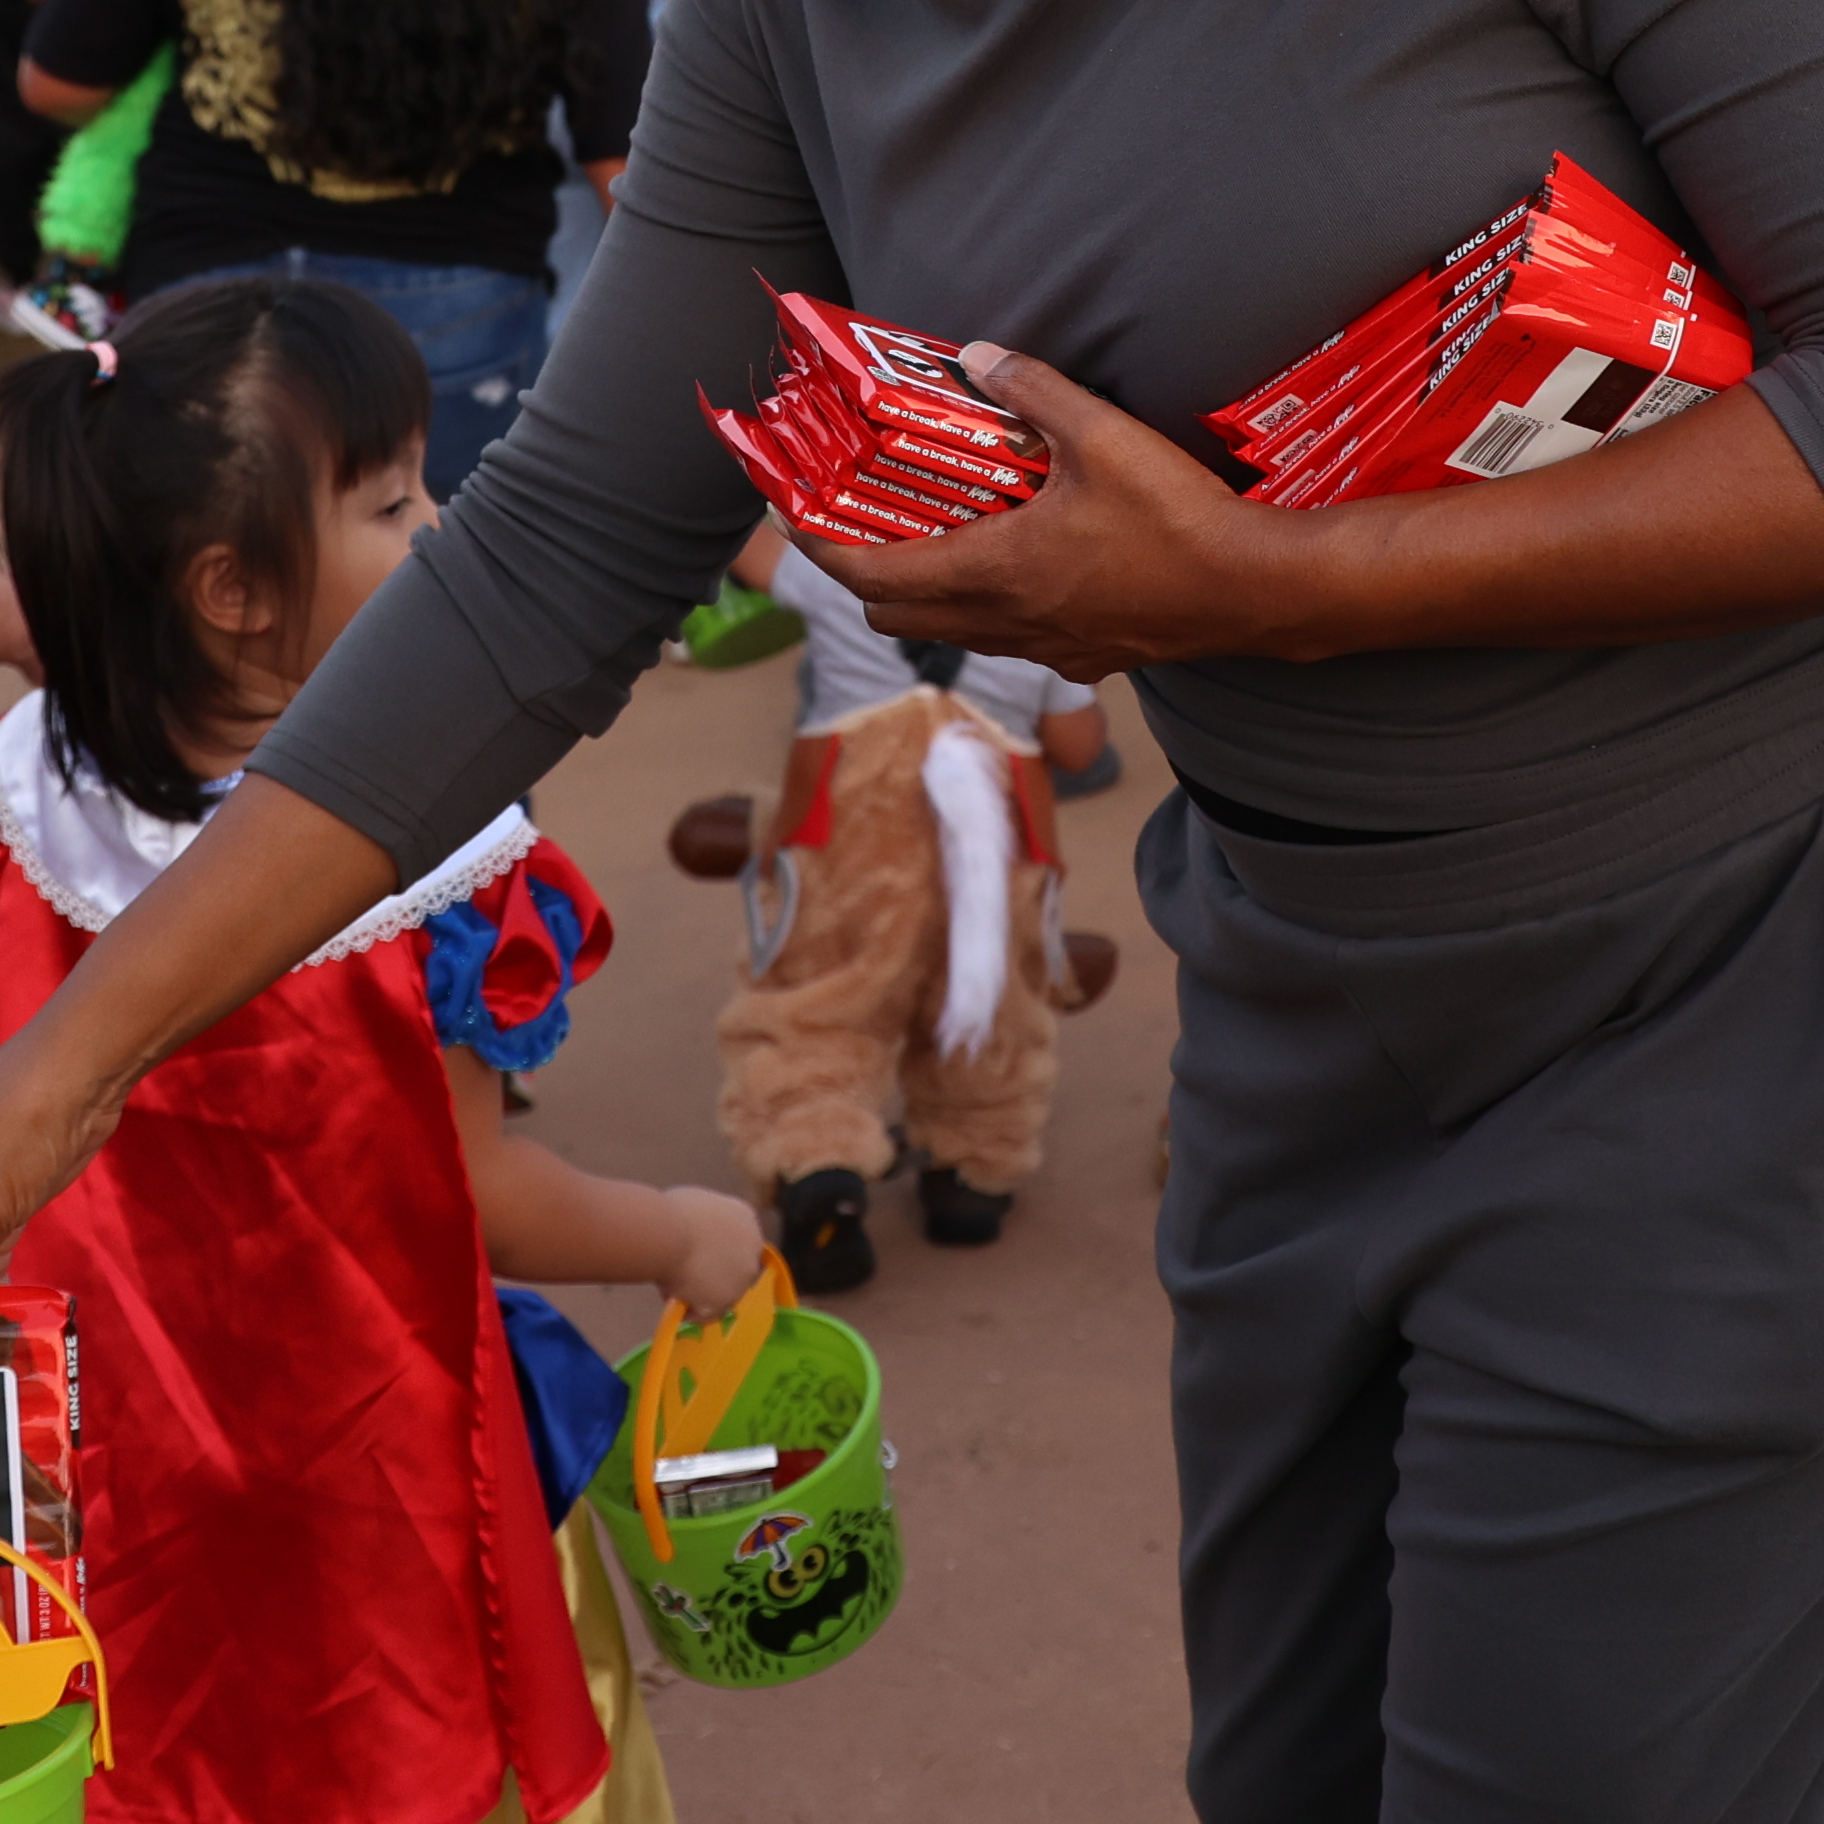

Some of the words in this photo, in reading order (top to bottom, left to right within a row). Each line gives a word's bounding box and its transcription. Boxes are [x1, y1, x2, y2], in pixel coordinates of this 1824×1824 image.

[1445, 230, 1487, 266] KING
[1453, 258, 1492, 296] KING
[1496, 232, 1526, 262] SIZ
[1441, 294, 1478, 333] KING
[1481, 267, 1510, 297] SIZ
[1429, 352, 1460, 392] KING
[1463, 315, 1492, 351] SIZE
[1647, 401, 1661, 415] size
[1658, 379, 1681, 403] Serving
[878, 399, 900, 416] have
[901, 409, 908, 419] a
[909, 410, 938, 429] break,
[939, 419, 962, 437] have
[963, 429, 970, 439] a
[970, 428, 999, 447] KitKat
[874, 452, 897, 469] have
[898, 462, 905, 472] a
[906, 463, 936, 484] break,
[937, 474, 960, 492] have
[960, 483, 968, 493] a
[967, 484, 997, 503] KitKat
[898, 438, 921, 455] have
[922, 447, 929, 457] a
[929, 448, 959, 469] break,
[960, 458, 983, 476] have
[983, 467, 991, 477] a
[990, 467, 1020, 486] KitKat
[836, 494, 859, 509] have
[860, 502, 867, 512] a
[868, 504, 898, 524] break,
[898, 515, 922, 532] have
[922, 524, 930, 534] a
[856, 471, 879, 487] have
[880, 480, 887, 490] a
[887, 482, 917, 502] break,
[918, 492, 942, 510] have
[942, 502, 950, 512] a
[803, 511, 825, 526] have
[826, 519, 834, 529] a
[834, 521, 863, 540] break,
[66, 1334, 78, 1381] SIZE
[67, 1383, 80, 1431] KING
